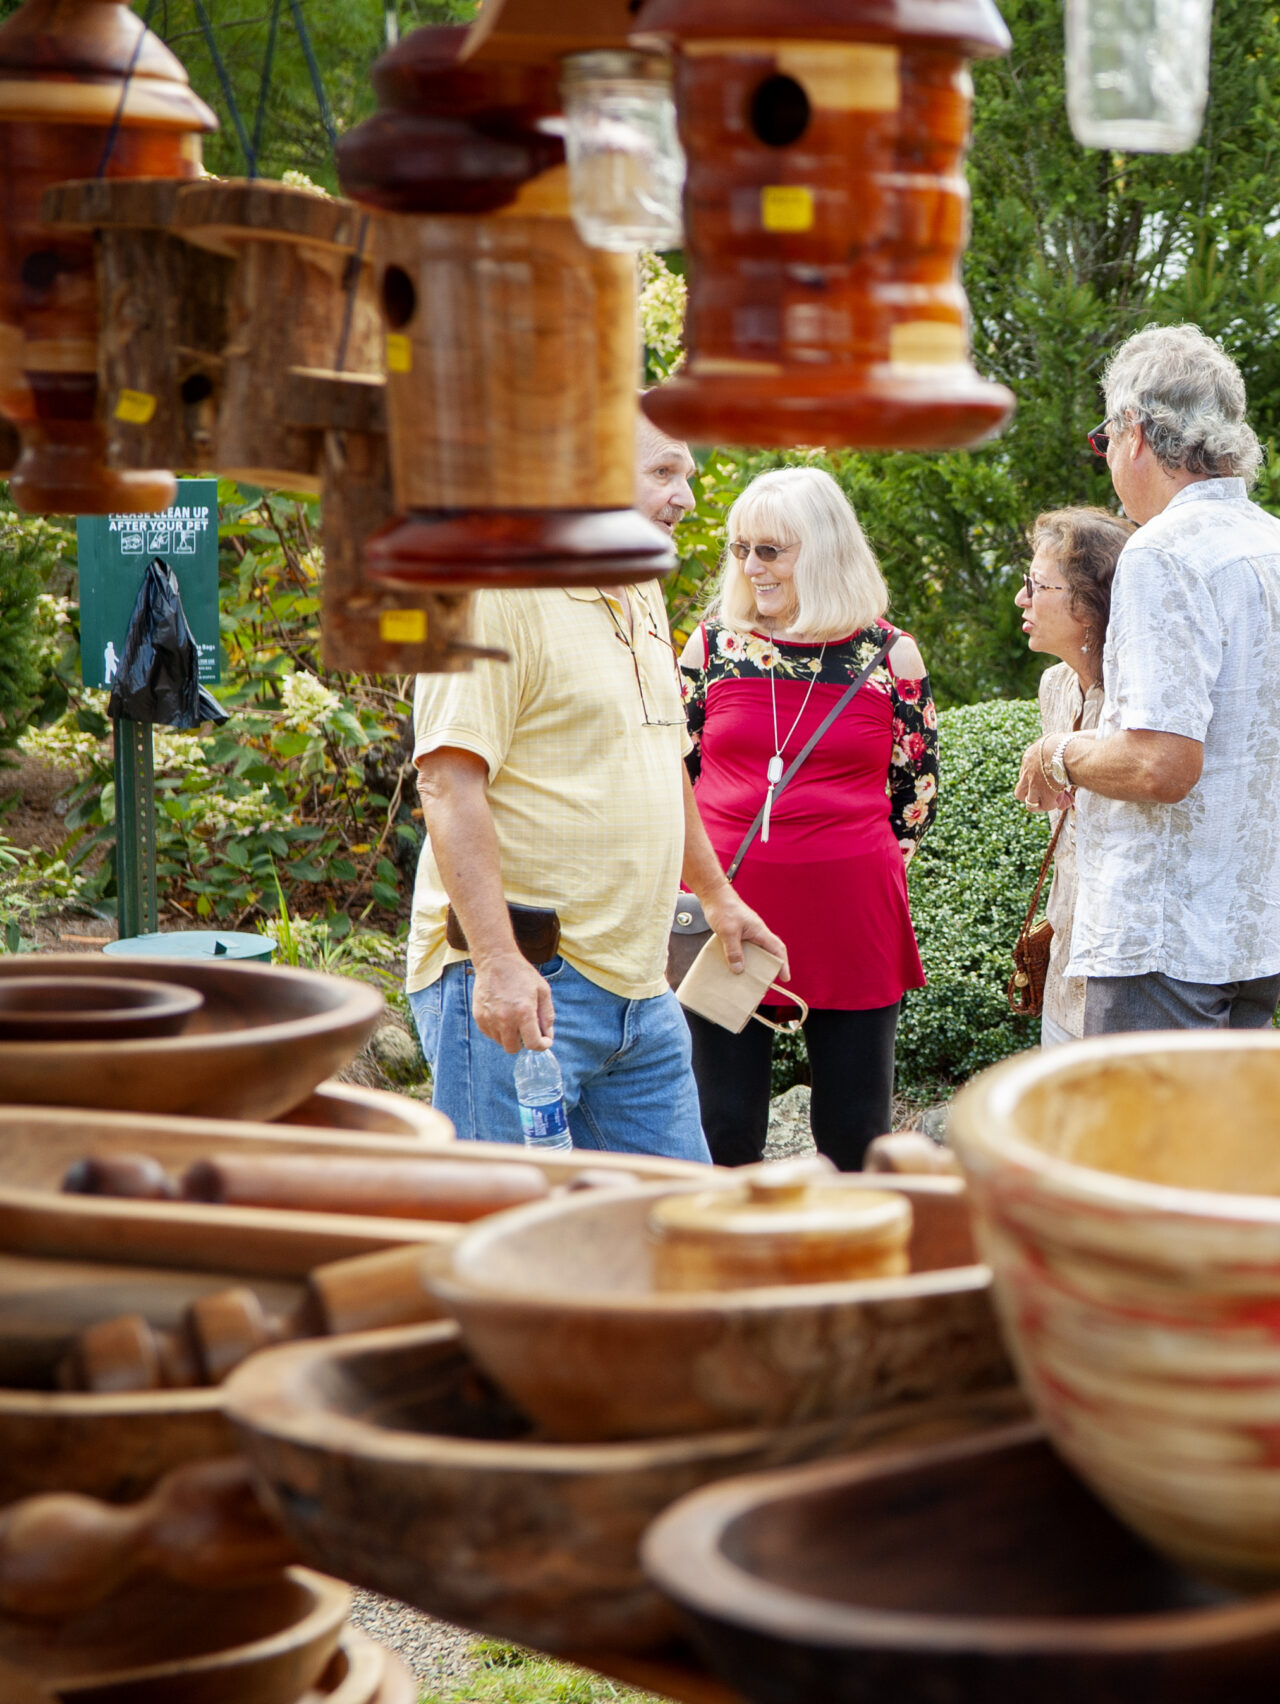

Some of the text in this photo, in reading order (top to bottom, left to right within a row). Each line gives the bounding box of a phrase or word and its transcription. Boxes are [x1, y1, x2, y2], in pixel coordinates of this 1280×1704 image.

[193, 506, 209, 519] UP
[109, 520, 209, 531] AFTER YOUR PET
